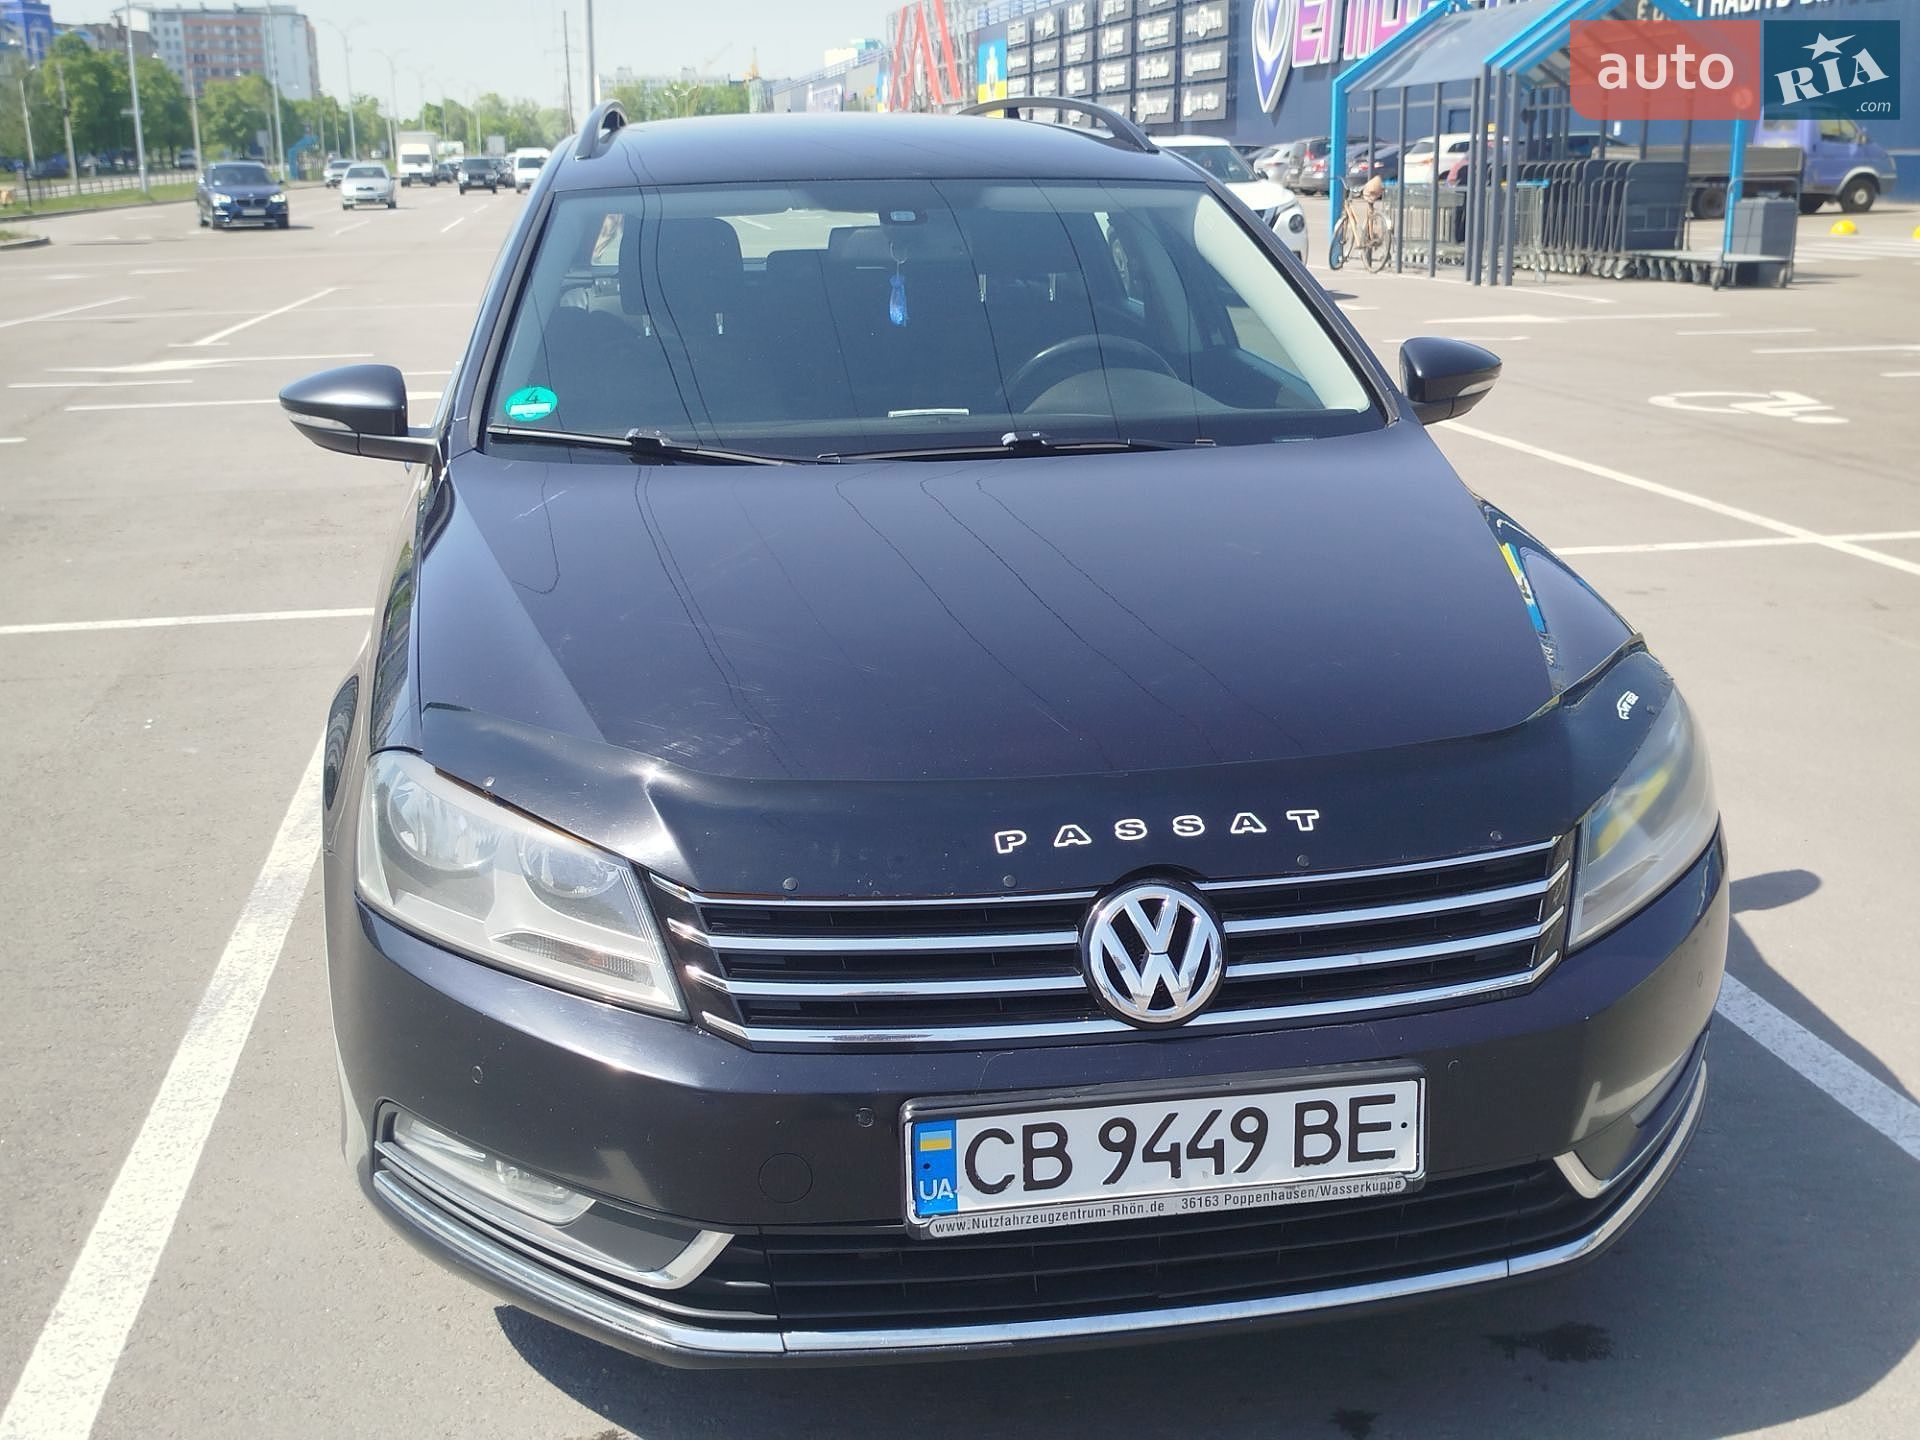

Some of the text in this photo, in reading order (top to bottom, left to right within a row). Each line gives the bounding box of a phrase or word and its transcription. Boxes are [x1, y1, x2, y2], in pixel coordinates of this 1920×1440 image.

[993, 809, 1320, 854] PASSAT
[964, 1094, 1397, 1195] CB 9449 BE
[919, 1177, 954, 1201] UA
[935, 1178, 1402, 1234] www.Nutzfahrzeugzentrum-Rhön.de 36163 Poppenhausen/Wasserkuppe
